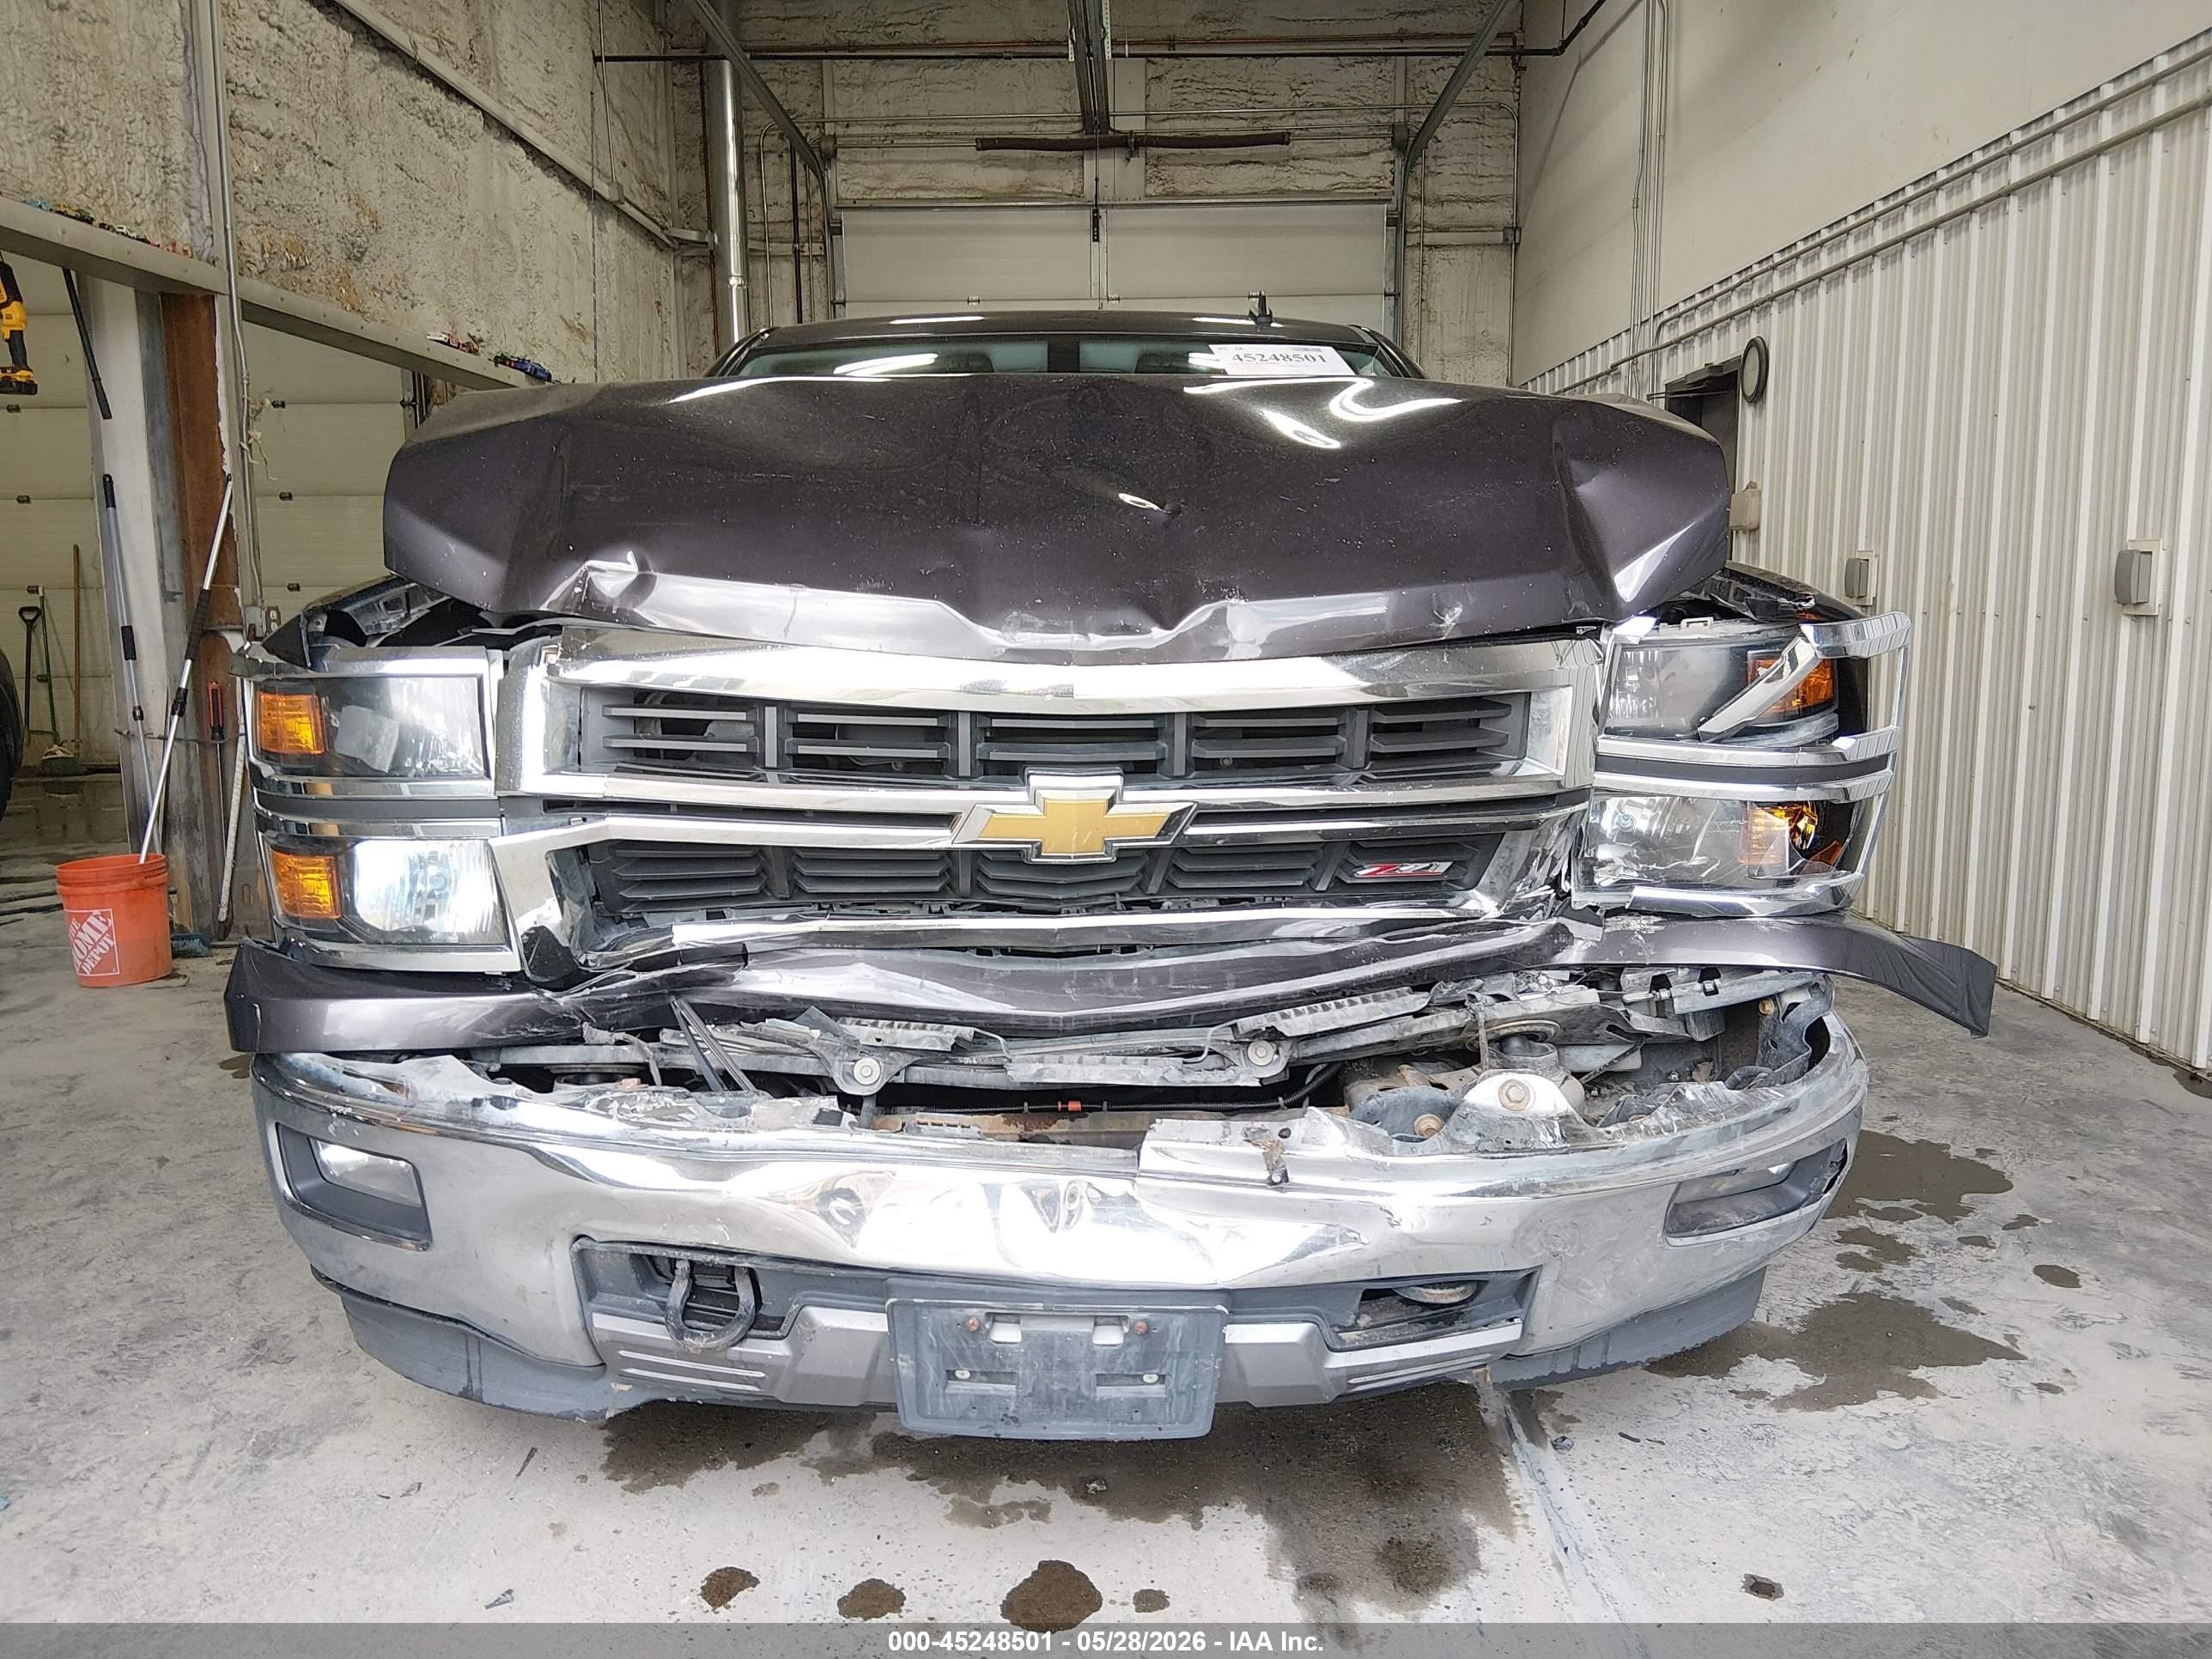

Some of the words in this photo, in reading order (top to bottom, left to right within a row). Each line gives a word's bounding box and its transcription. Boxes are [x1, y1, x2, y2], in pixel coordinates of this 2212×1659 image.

[1232, 353, 1327, 363] 45248501
[1354, 860, 1454, 878] Z71
[82, 933, 113, 975] DEPOT
